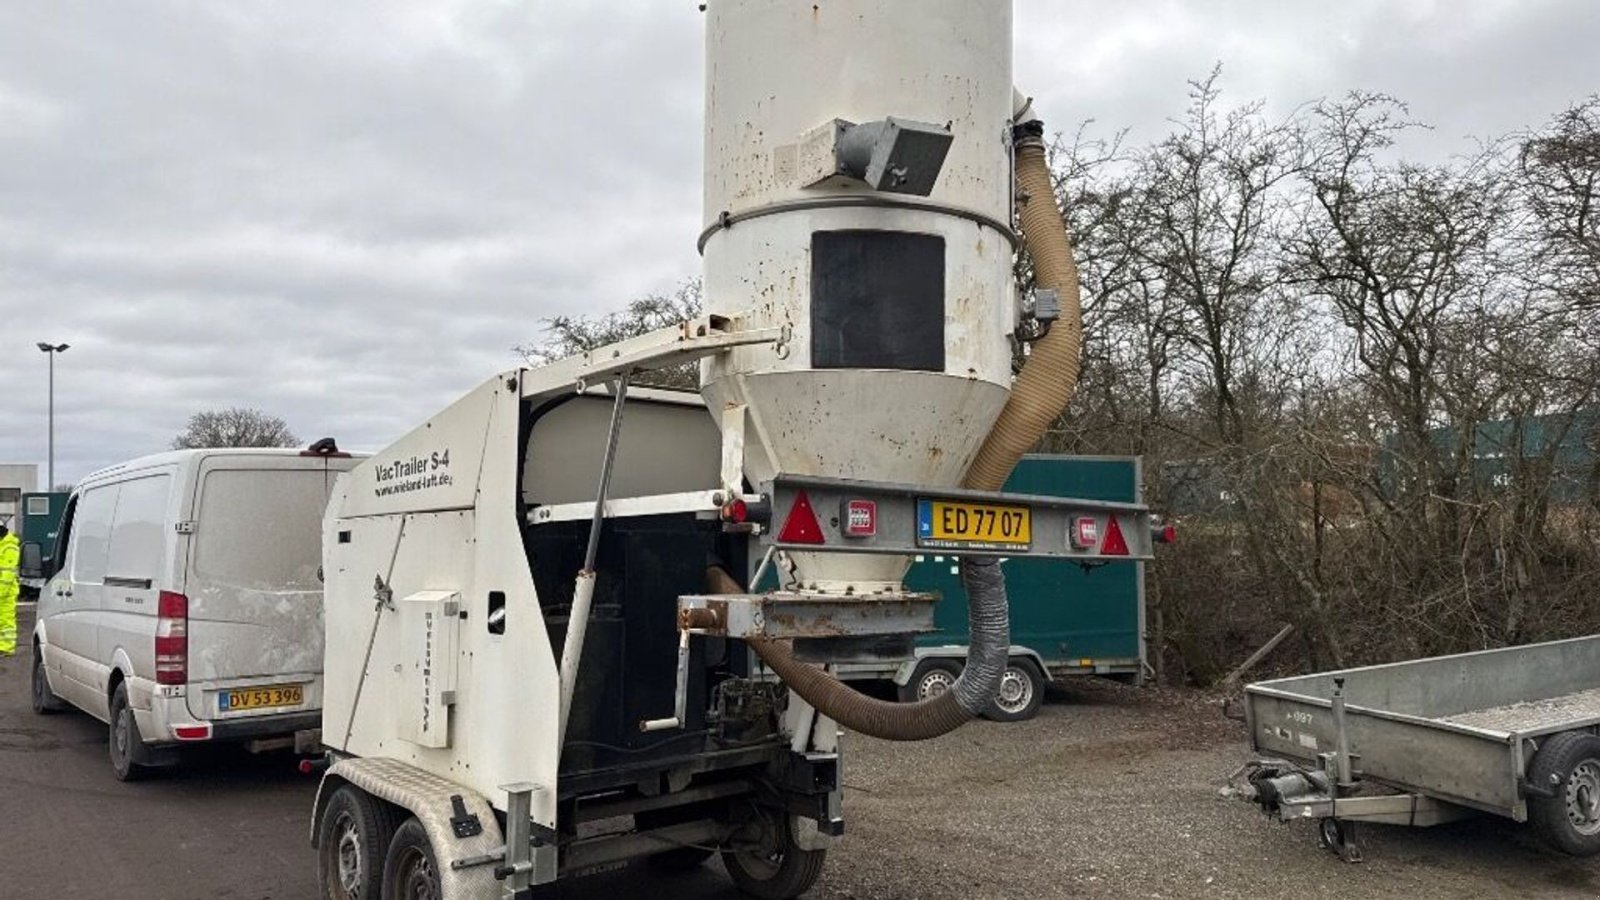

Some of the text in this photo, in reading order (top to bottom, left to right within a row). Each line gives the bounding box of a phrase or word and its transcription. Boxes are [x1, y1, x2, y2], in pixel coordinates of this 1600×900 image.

[375, 456, 428, 482] VacTrailer
[943, 507, 1023, 537] ED 77 07
[230, 688, 300, 707] DV 53 396
